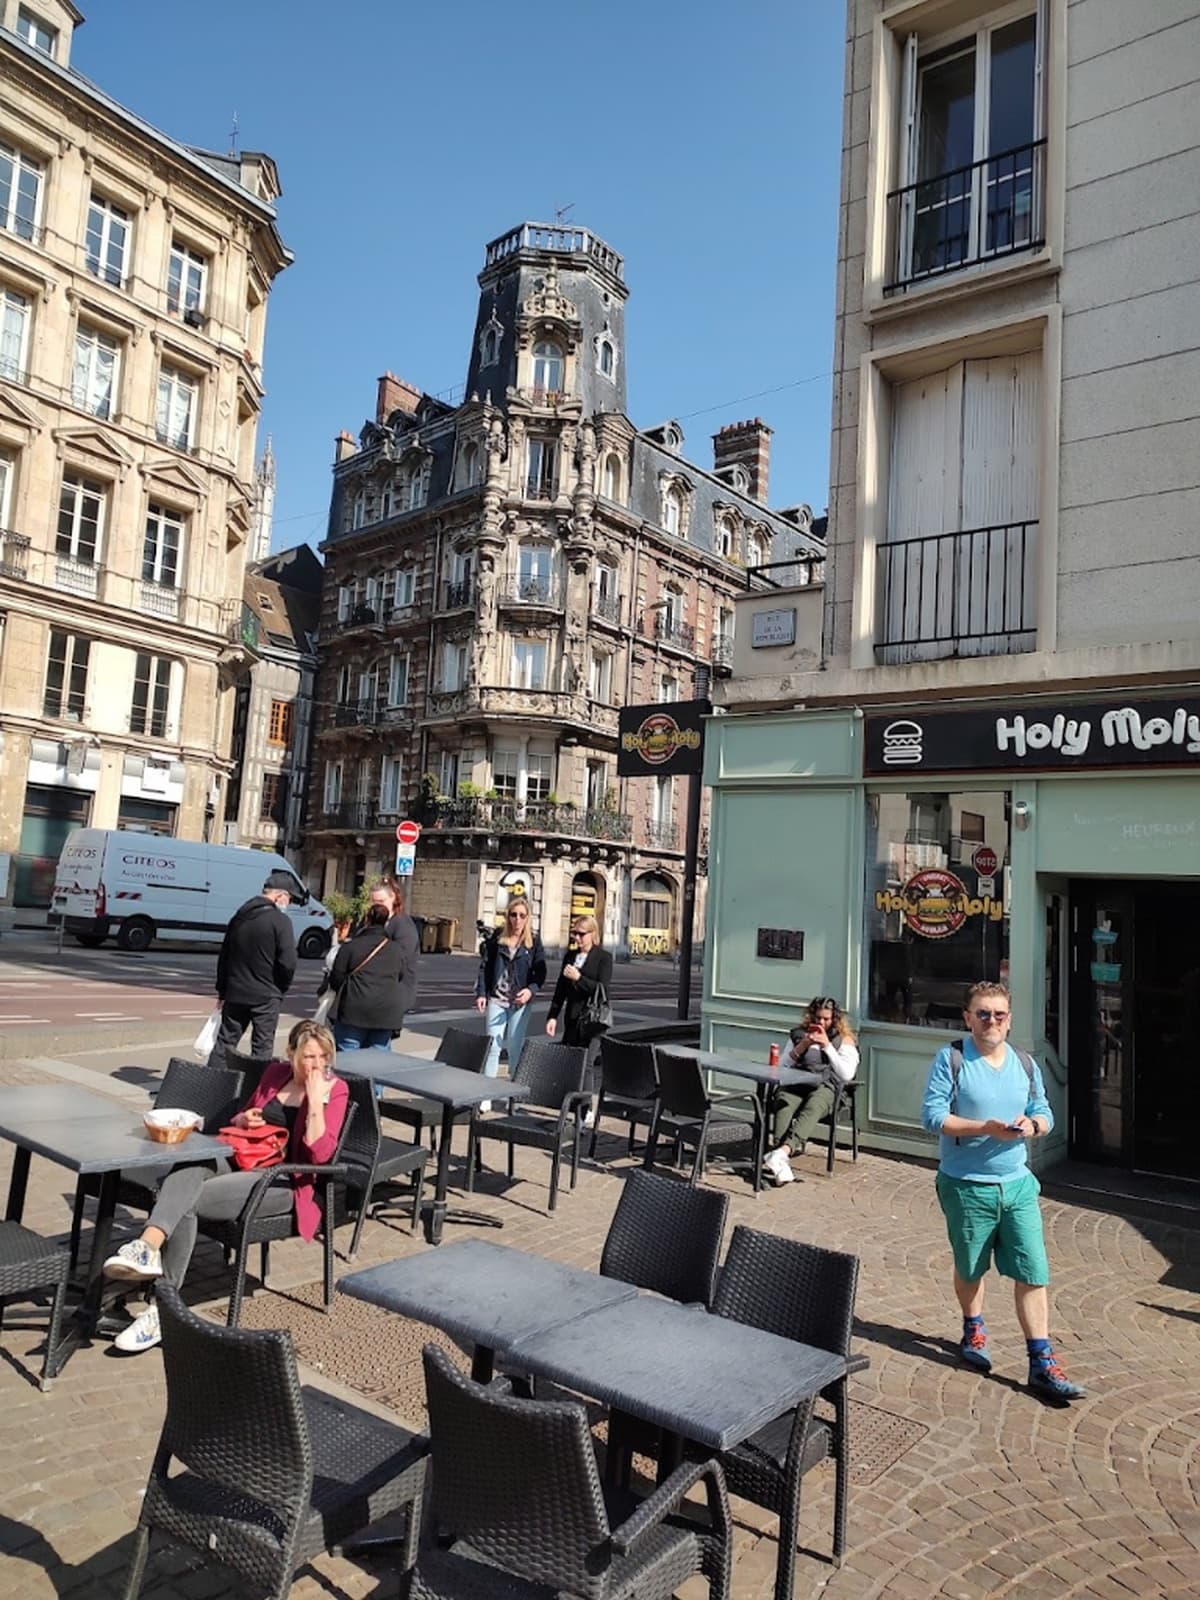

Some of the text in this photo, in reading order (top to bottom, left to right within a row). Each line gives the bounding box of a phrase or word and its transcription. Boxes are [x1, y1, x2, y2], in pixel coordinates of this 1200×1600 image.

[996, 714, 1091, 757] Holy
[122, 855, 176, 869] CITEOS
[875, 890, 918, 916] Holy
